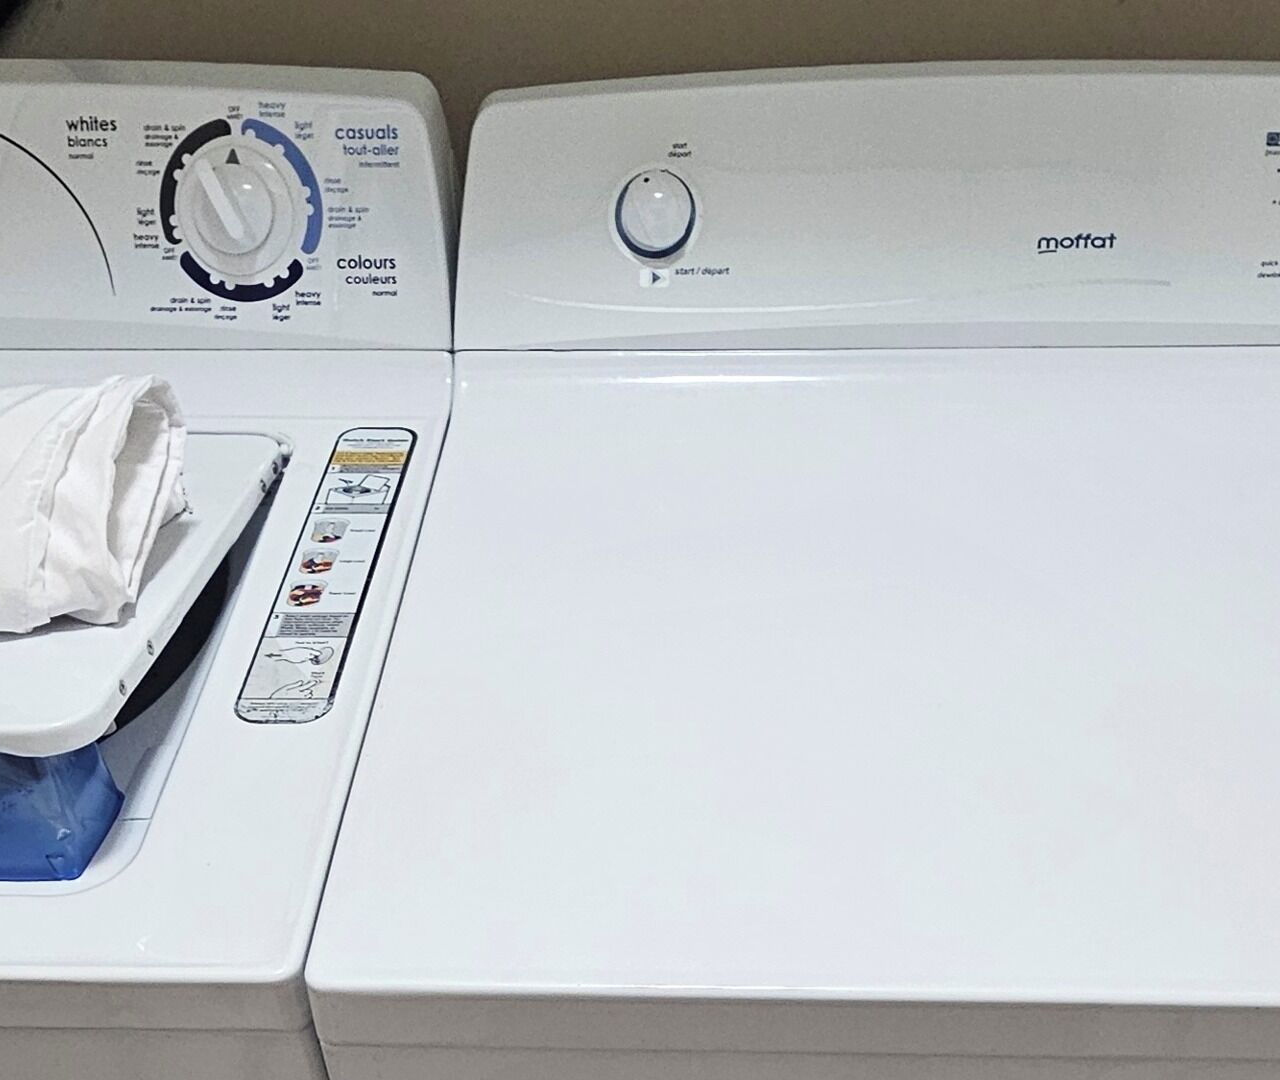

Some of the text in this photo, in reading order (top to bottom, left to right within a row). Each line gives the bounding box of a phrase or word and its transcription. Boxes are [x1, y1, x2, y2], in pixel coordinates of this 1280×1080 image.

[65, 116, 118, 133] whites
[335, 123, 399, 140] casuals
[67, 133, 109, 148] blancs
[342, 143, 400, 156] tout-aller
[1037, 232, 1117, 253] moffat
[336, 254, 397, 270] colours
[675, 267, 695, 275] start
[345, 273, 398, 285] couleurs
[294, 290, 321, 299] heavy
